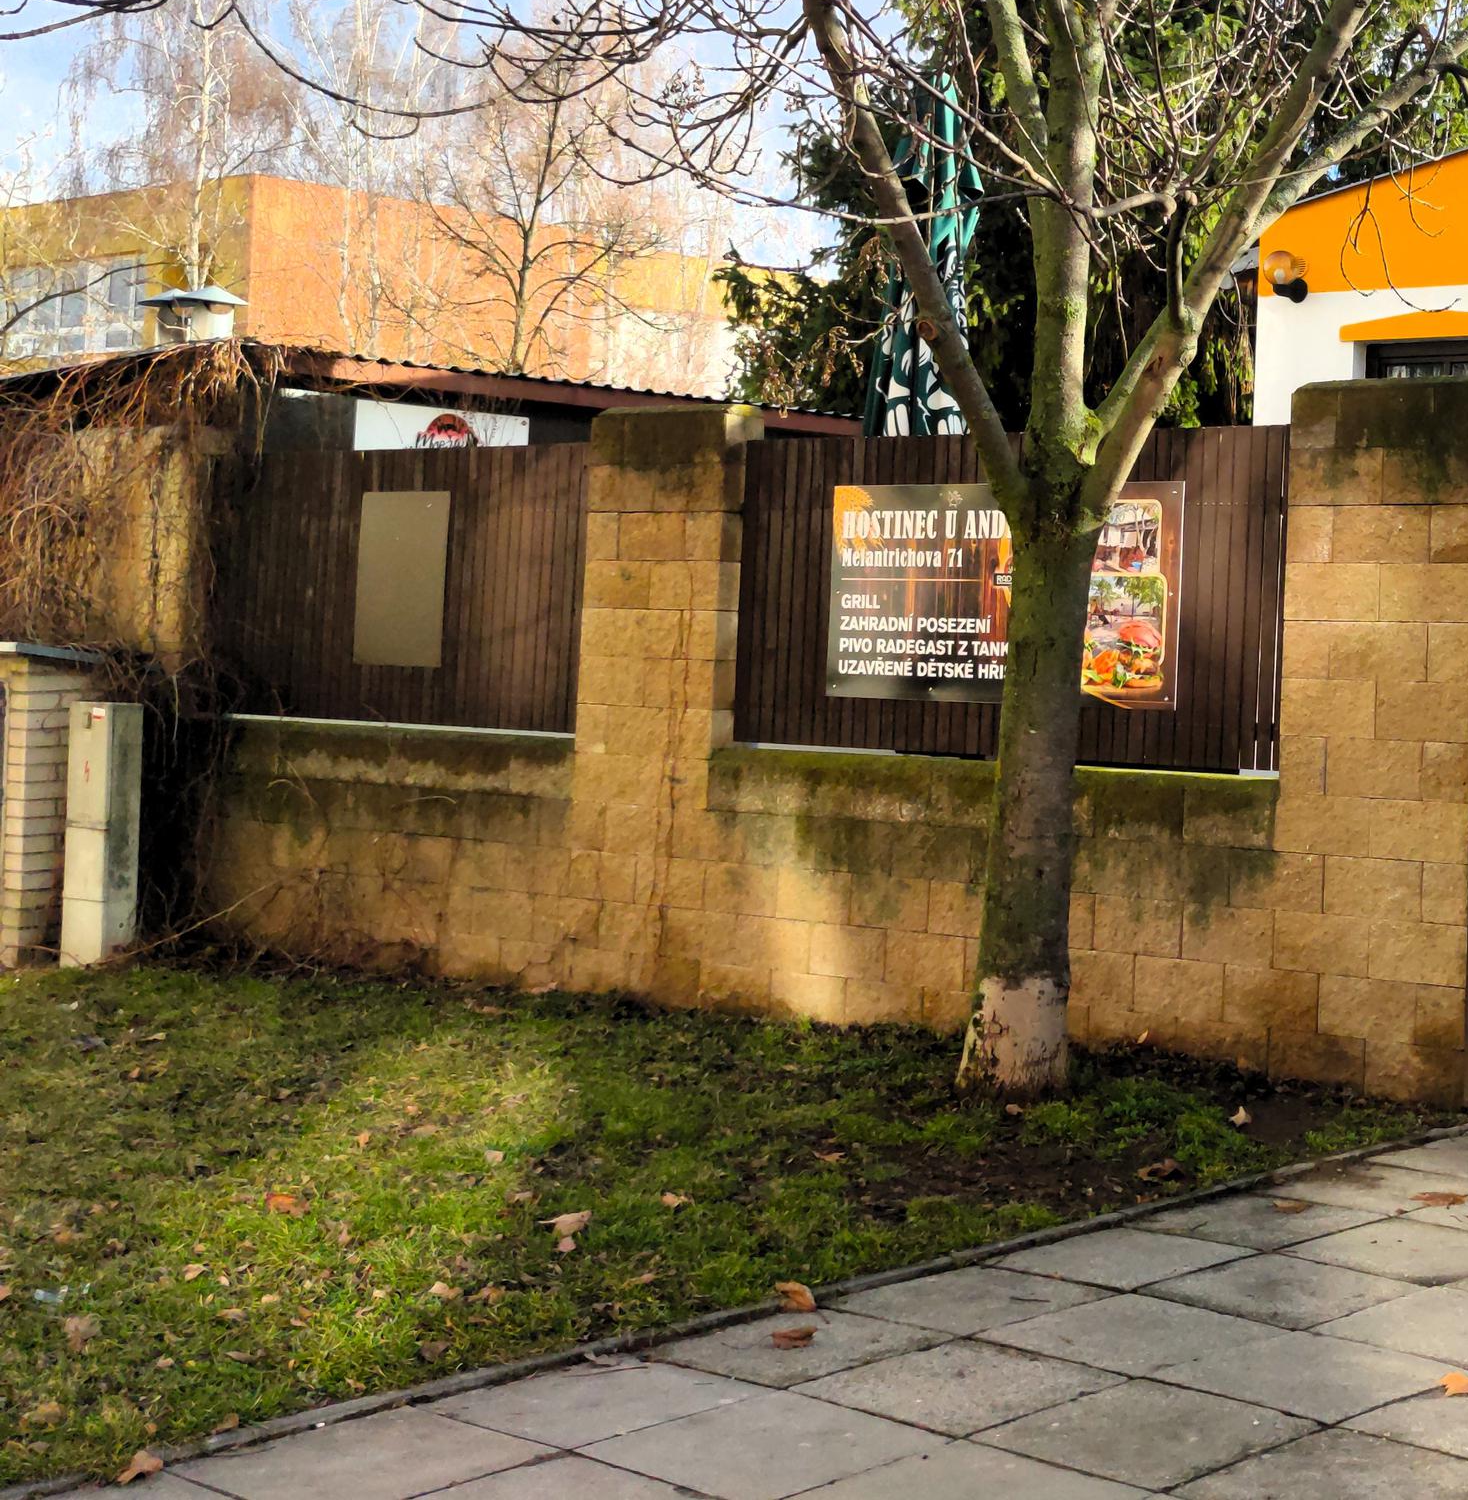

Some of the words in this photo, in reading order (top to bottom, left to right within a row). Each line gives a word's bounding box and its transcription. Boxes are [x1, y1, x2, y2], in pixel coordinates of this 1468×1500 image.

[842, 510, 938, 540] HOSTINEC
[945, 510, 957, 540] U
[964, 510, 1012, 540] AND
[841, 547, 942, 568] Melantrichova
[948, 548, 963, 568] 71
[841, 594, 881, 609] GRILL
[840, 613, 914, 631] ZAHRADNÍ
[917, 615, 991, 634] POSEZENÍ
[839, 638, 872, 653] PIVO
[876, 639, 957, 656] RADEGAST
[958, 641, 968, 656] Z
[838, 657, 913, 676] UZAVŘENÉ
[916, 658, 974, 678] DĚTSKÉ
